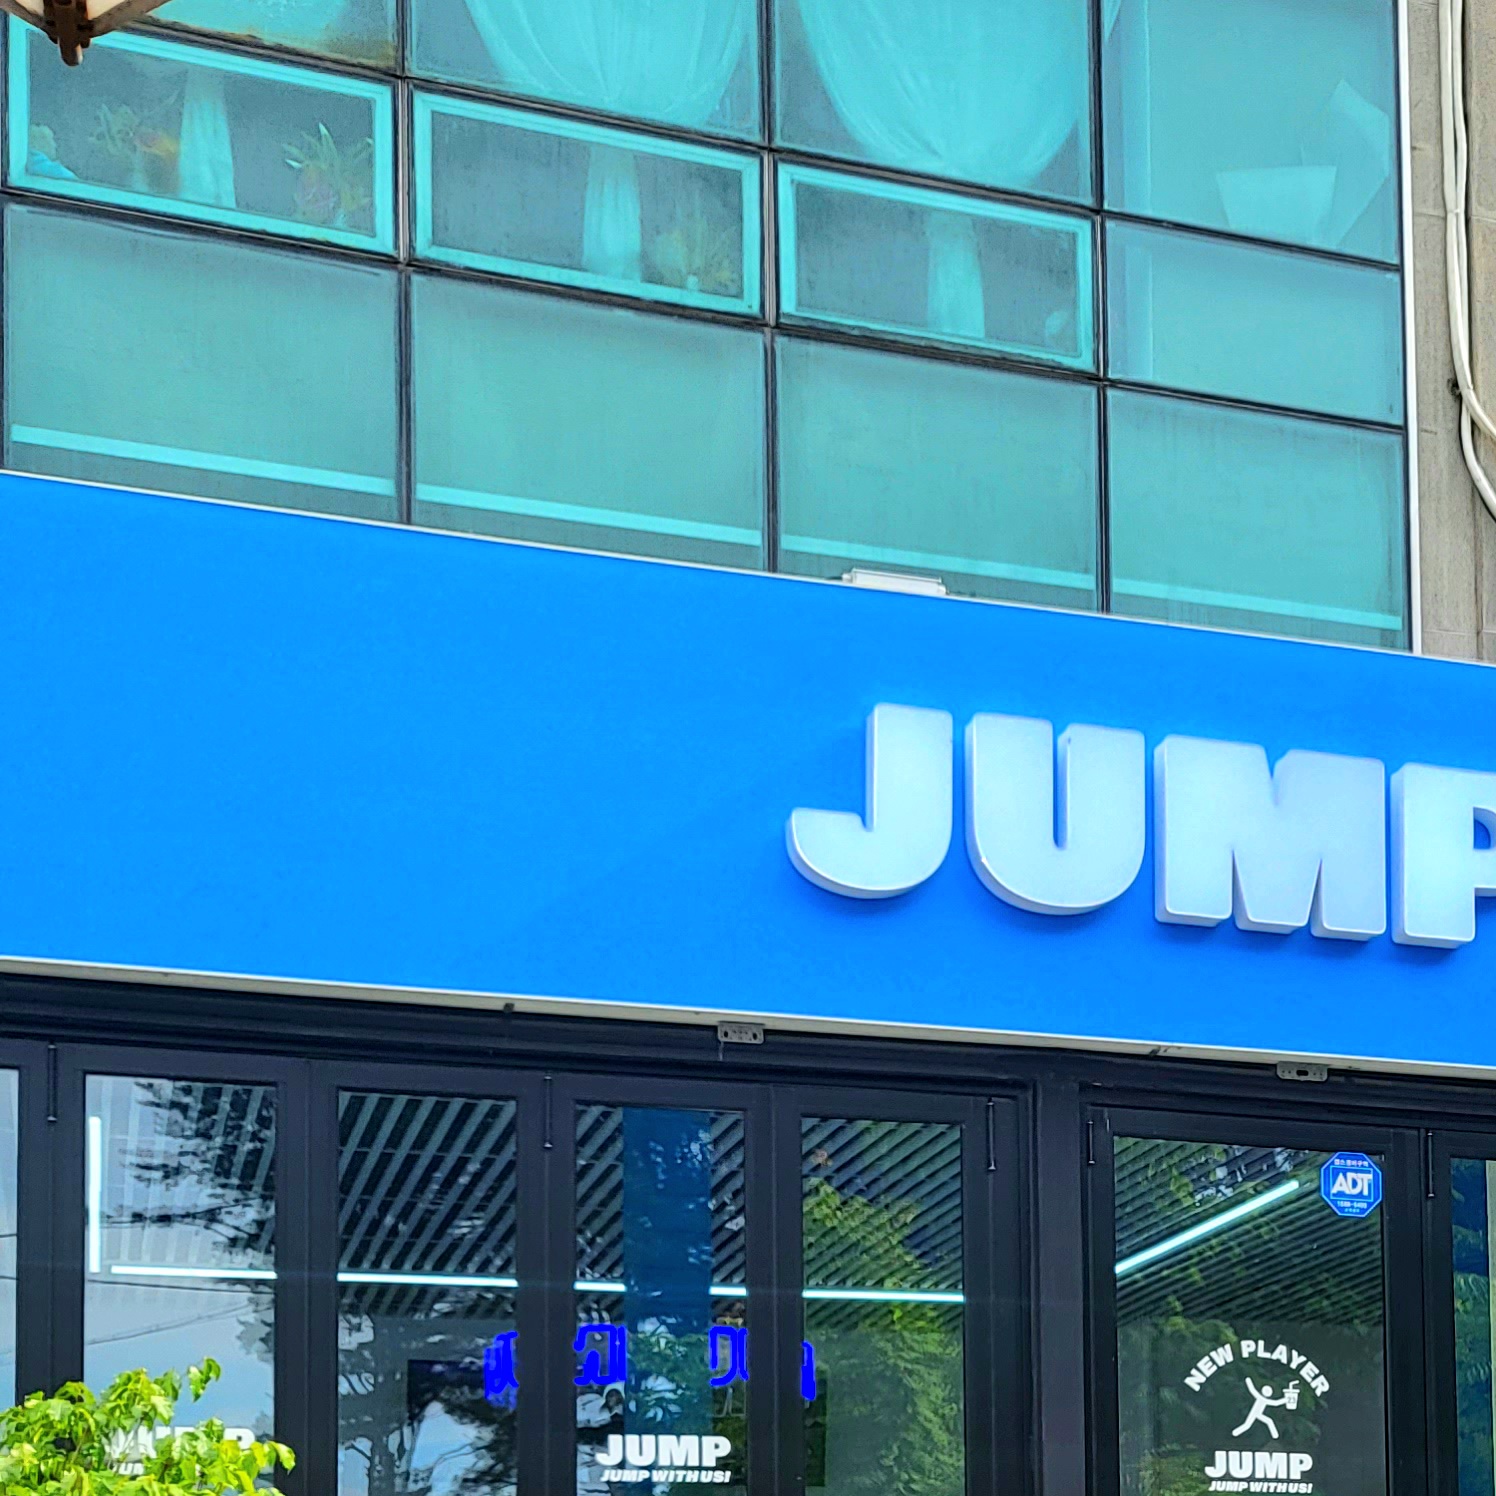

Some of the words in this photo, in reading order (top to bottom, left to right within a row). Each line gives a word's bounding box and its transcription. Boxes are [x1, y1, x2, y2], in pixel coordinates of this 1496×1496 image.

[1331, 1172, 1372, 1196] ADT
[1184, 1343, 1234, 1392] NEW
[1240, 1339, 1330, 1397] PLAYER
[595, 1434, 731, 1467] JUMP
[601, 1470, 650, 1482] JUMP
[1204, 1451, 1313, 1480] JUMP
[1208, 1481, 1248, 1492] JUMP
